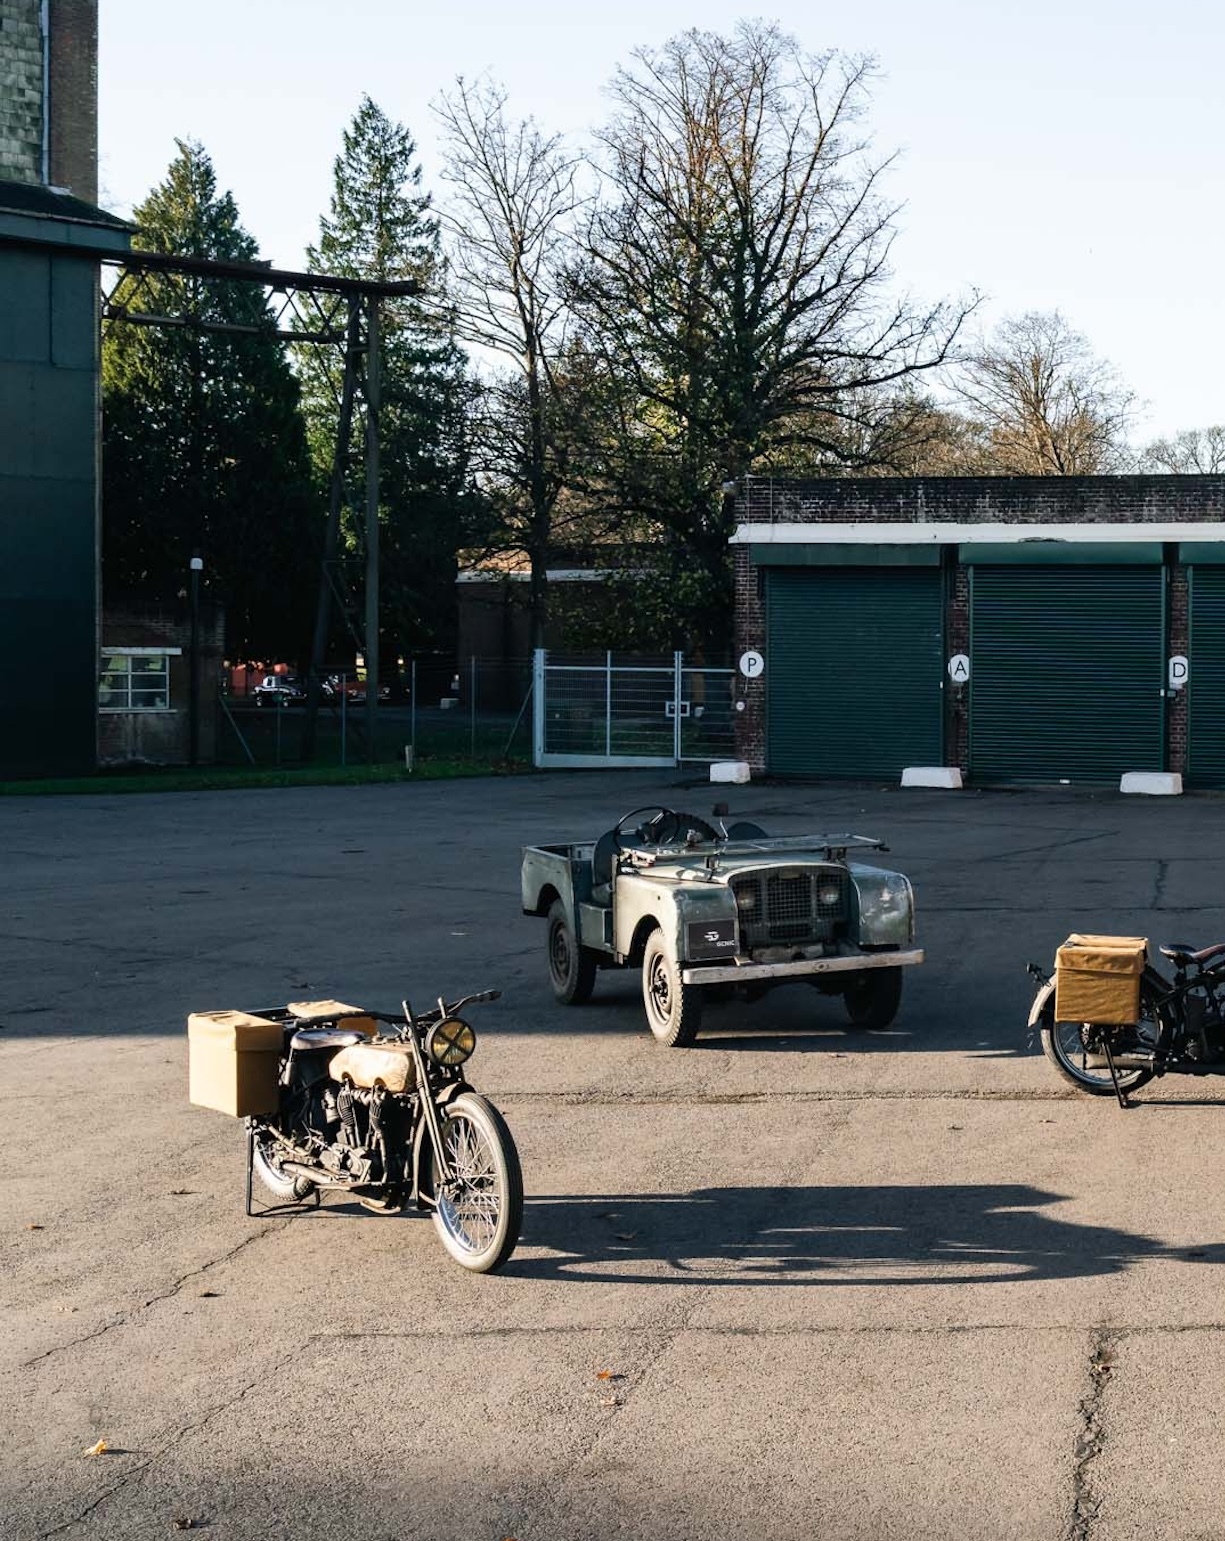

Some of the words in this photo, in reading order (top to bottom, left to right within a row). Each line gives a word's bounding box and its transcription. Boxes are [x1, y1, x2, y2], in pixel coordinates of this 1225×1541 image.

[748, 657, 757, 672] P
[954, 660, 967, 675] A
[1173, 662, 1186, 677] D
